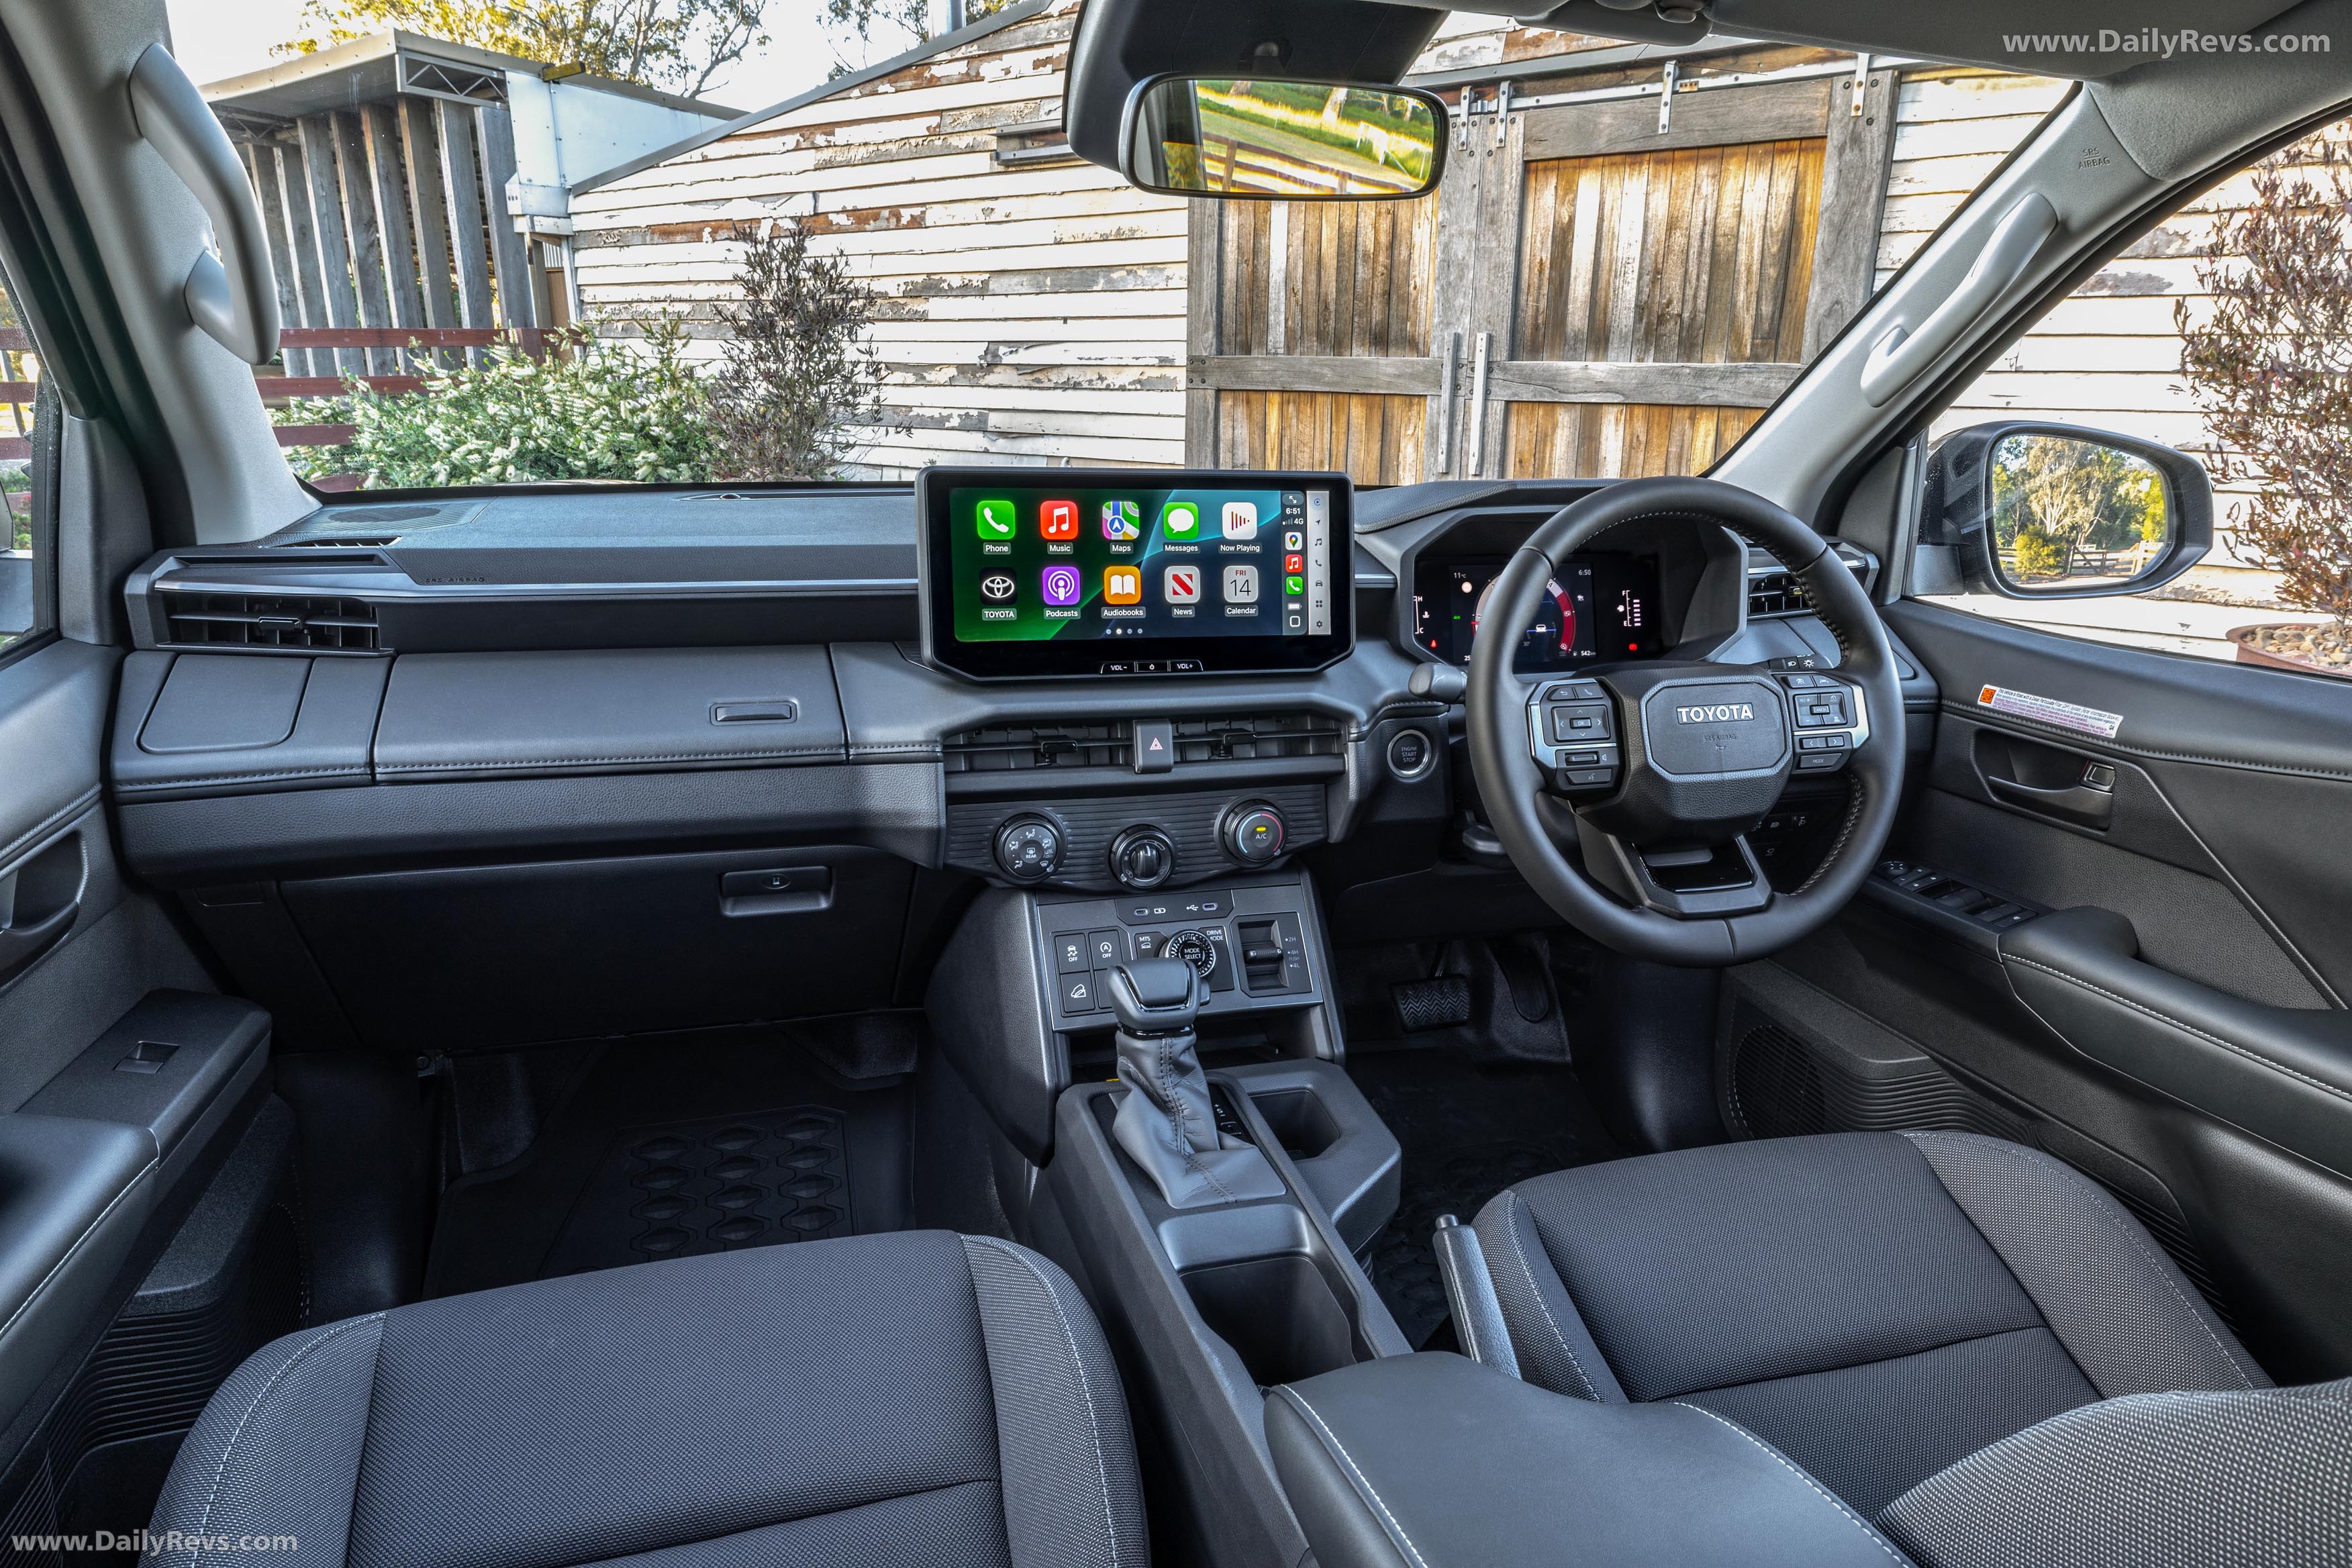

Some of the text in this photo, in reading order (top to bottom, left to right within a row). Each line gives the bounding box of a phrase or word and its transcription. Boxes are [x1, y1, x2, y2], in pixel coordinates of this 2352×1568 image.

[2083, 148, 2100, 157] SRS
[2079, 157, 2110, 169] AIRBAG
[985, 544, 1009, 552] Phone
[1049, 544, 1071, 552] Music
[1112, 544, 1131, 553] Maps
[1165, 544, 1198, 552] Messages
[1236, 544, 1260, 552] Playing
[1230, 579, 1251, 597] 14
[984, 610, 1014, 618] TOYOTA
[1677, 704, 1753, 722] TOYOTA
